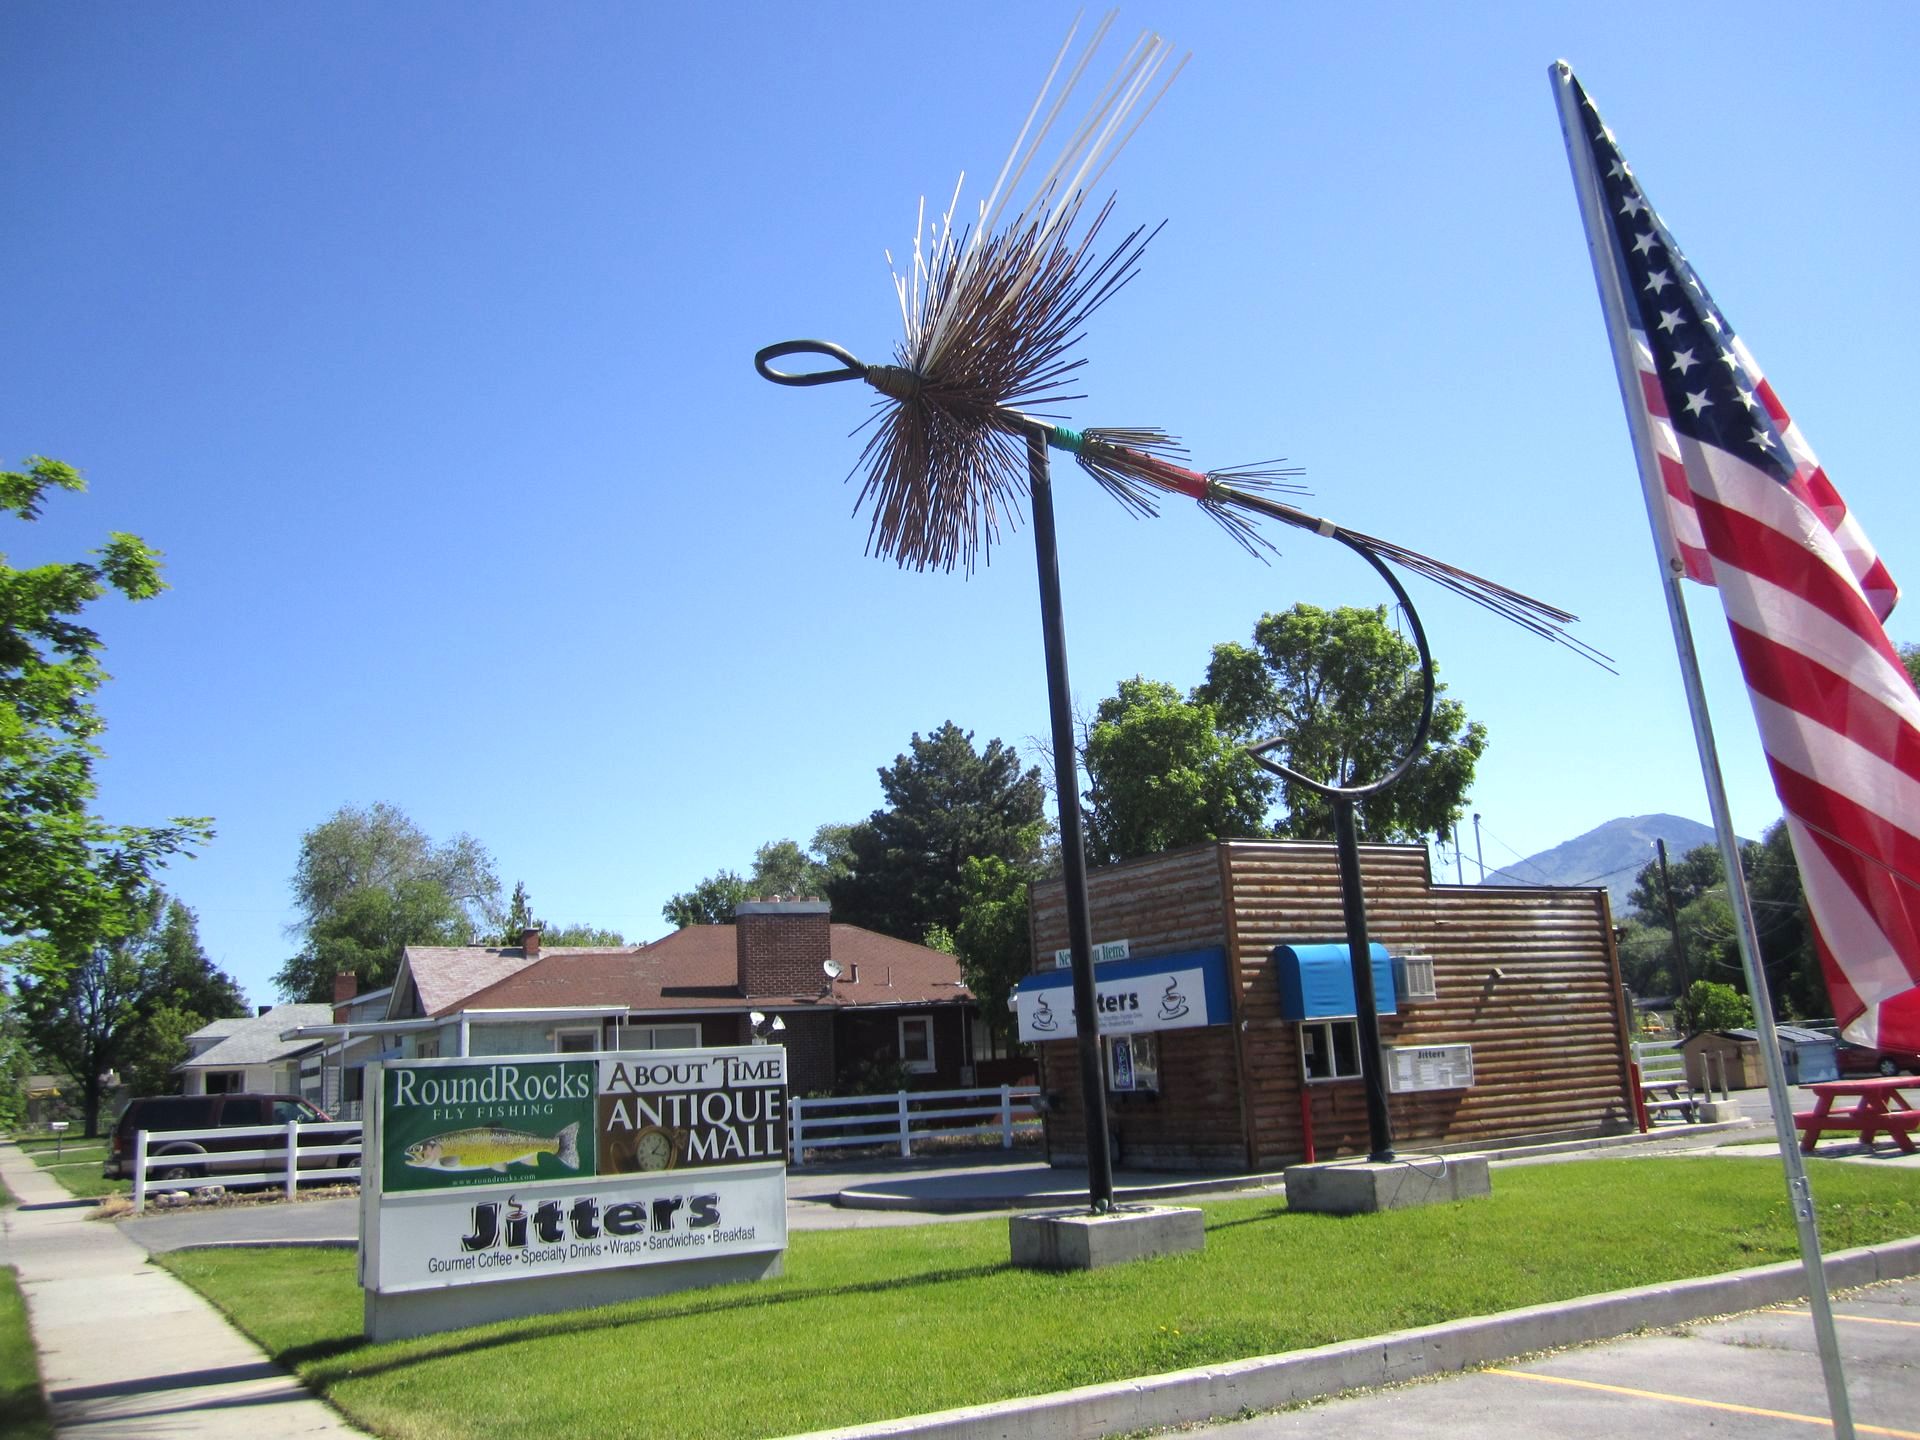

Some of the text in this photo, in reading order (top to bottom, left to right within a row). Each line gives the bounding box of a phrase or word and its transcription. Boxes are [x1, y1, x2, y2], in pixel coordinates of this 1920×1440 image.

[1102, 944, 1125, 960] Items
[1418, 1050, 1446, 1059] Jitters
[393, 1063, 589, 1107] RoundRocks
[606, 1056, 782, 1092] ABOUT TIME
[433, 1103, 554, 1120] FLY FISHING
[606, 1089, 781, 1132] ANTIQUE
[687, 1123, 782, 1162] MALL
[452, 1173, 536, 1185] www.roundrocks.com
[461, 1193, 721, 1252] Jitters
[428, 1226, 756, 1273] Gourmet Coffee Specialty Drinks Wraps Sandwiches Breakfast
